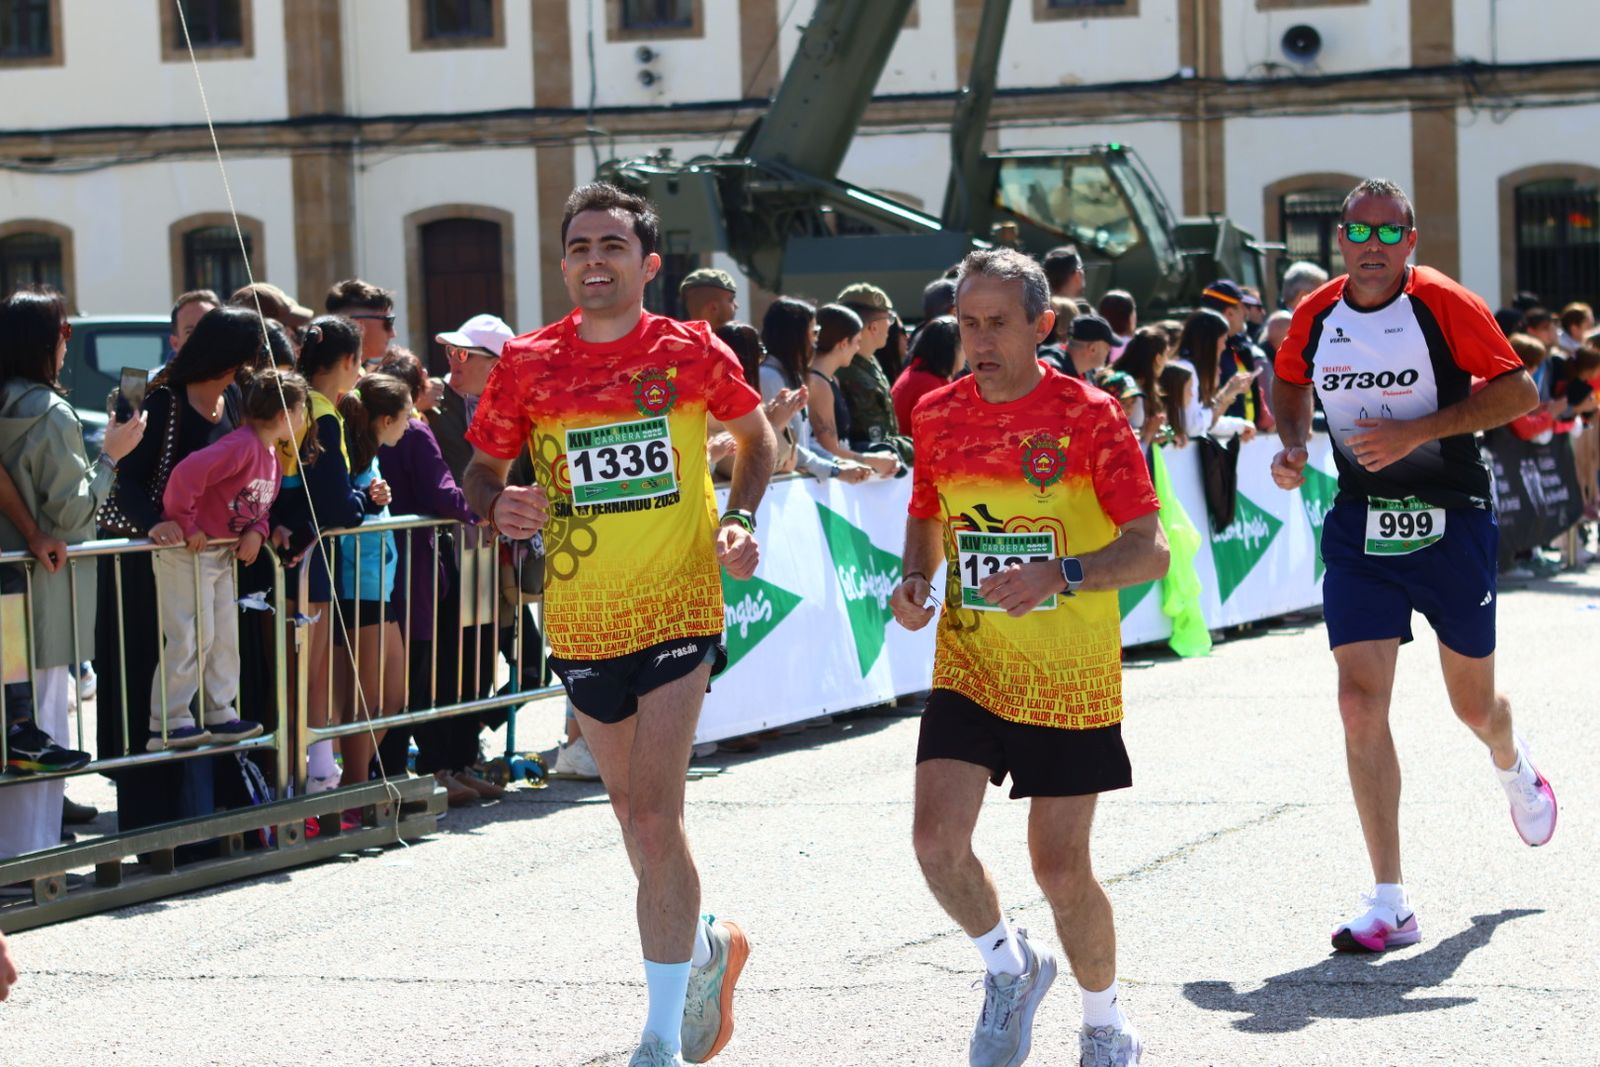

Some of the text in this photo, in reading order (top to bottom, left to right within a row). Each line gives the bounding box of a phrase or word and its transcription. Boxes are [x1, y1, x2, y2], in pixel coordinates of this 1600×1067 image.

[1322, 369, 1418, 391] 37300
[568, 432, 592, 448] XIV
[594, 431, 641, 445] CARRERA
[574, 440, 669, 483] 1336
[592, 498, 652, 516] FERNANDO
[1379, 511, 1433, 538] 999
[961, 536, 980, 550] XIV
[982, 543, 1025, 553] CARRERA
[965, 554, 1049, 586] 13
[671, 643, 698, 658] rasán
